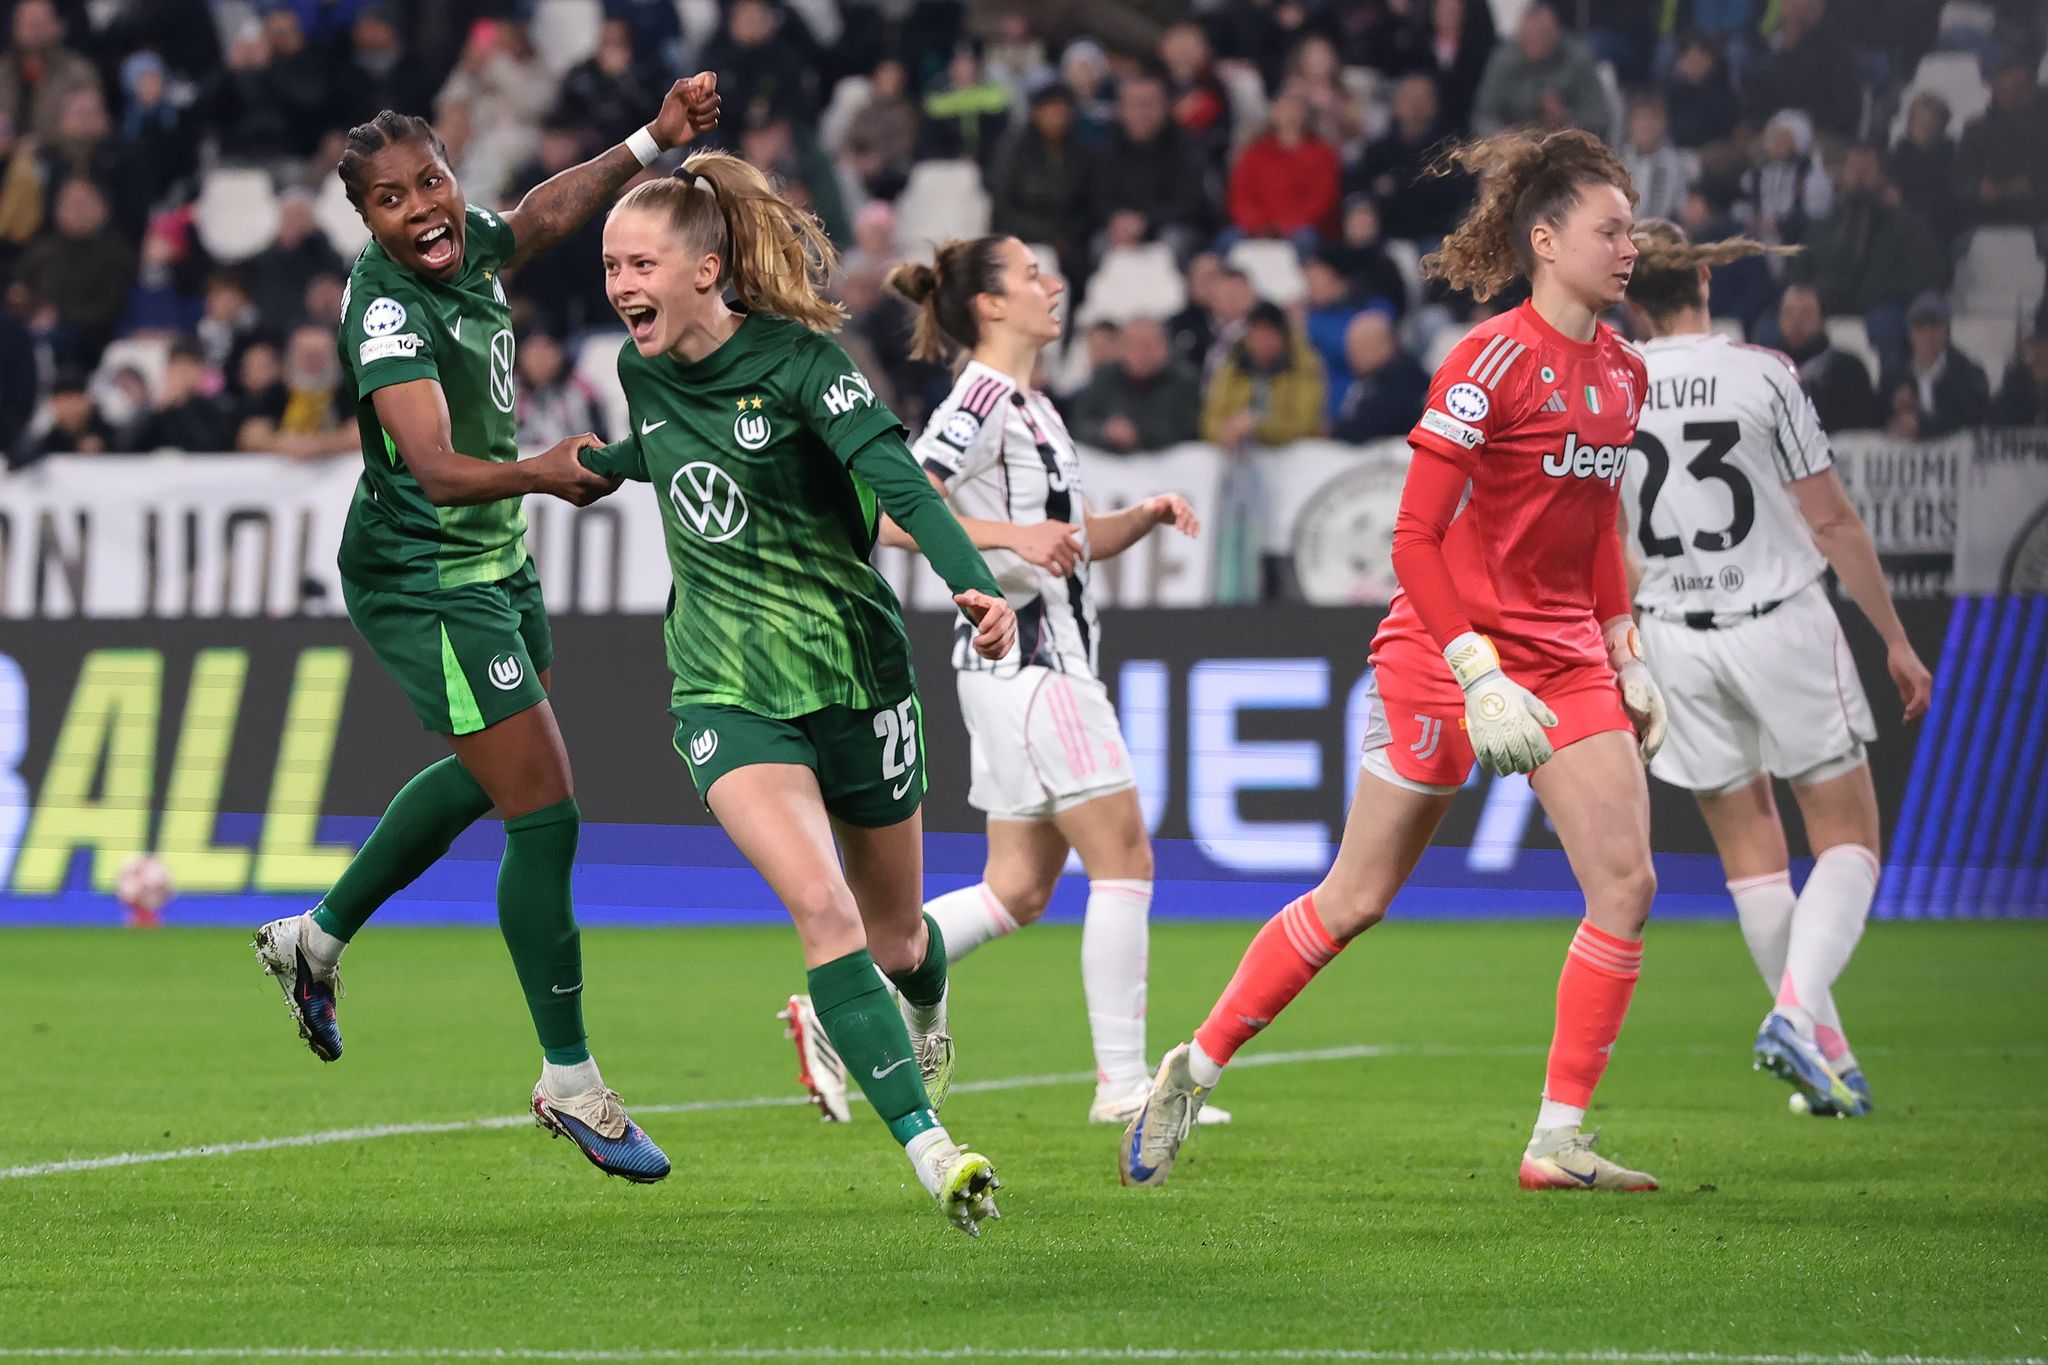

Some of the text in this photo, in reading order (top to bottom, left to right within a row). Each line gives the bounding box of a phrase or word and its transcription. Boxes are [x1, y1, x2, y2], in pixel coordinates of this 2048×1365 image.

[1541, 431, 1629, 488] Jeep
[1632, 420, 1755, 558] 23
[873, 694, 916, 781] 25
